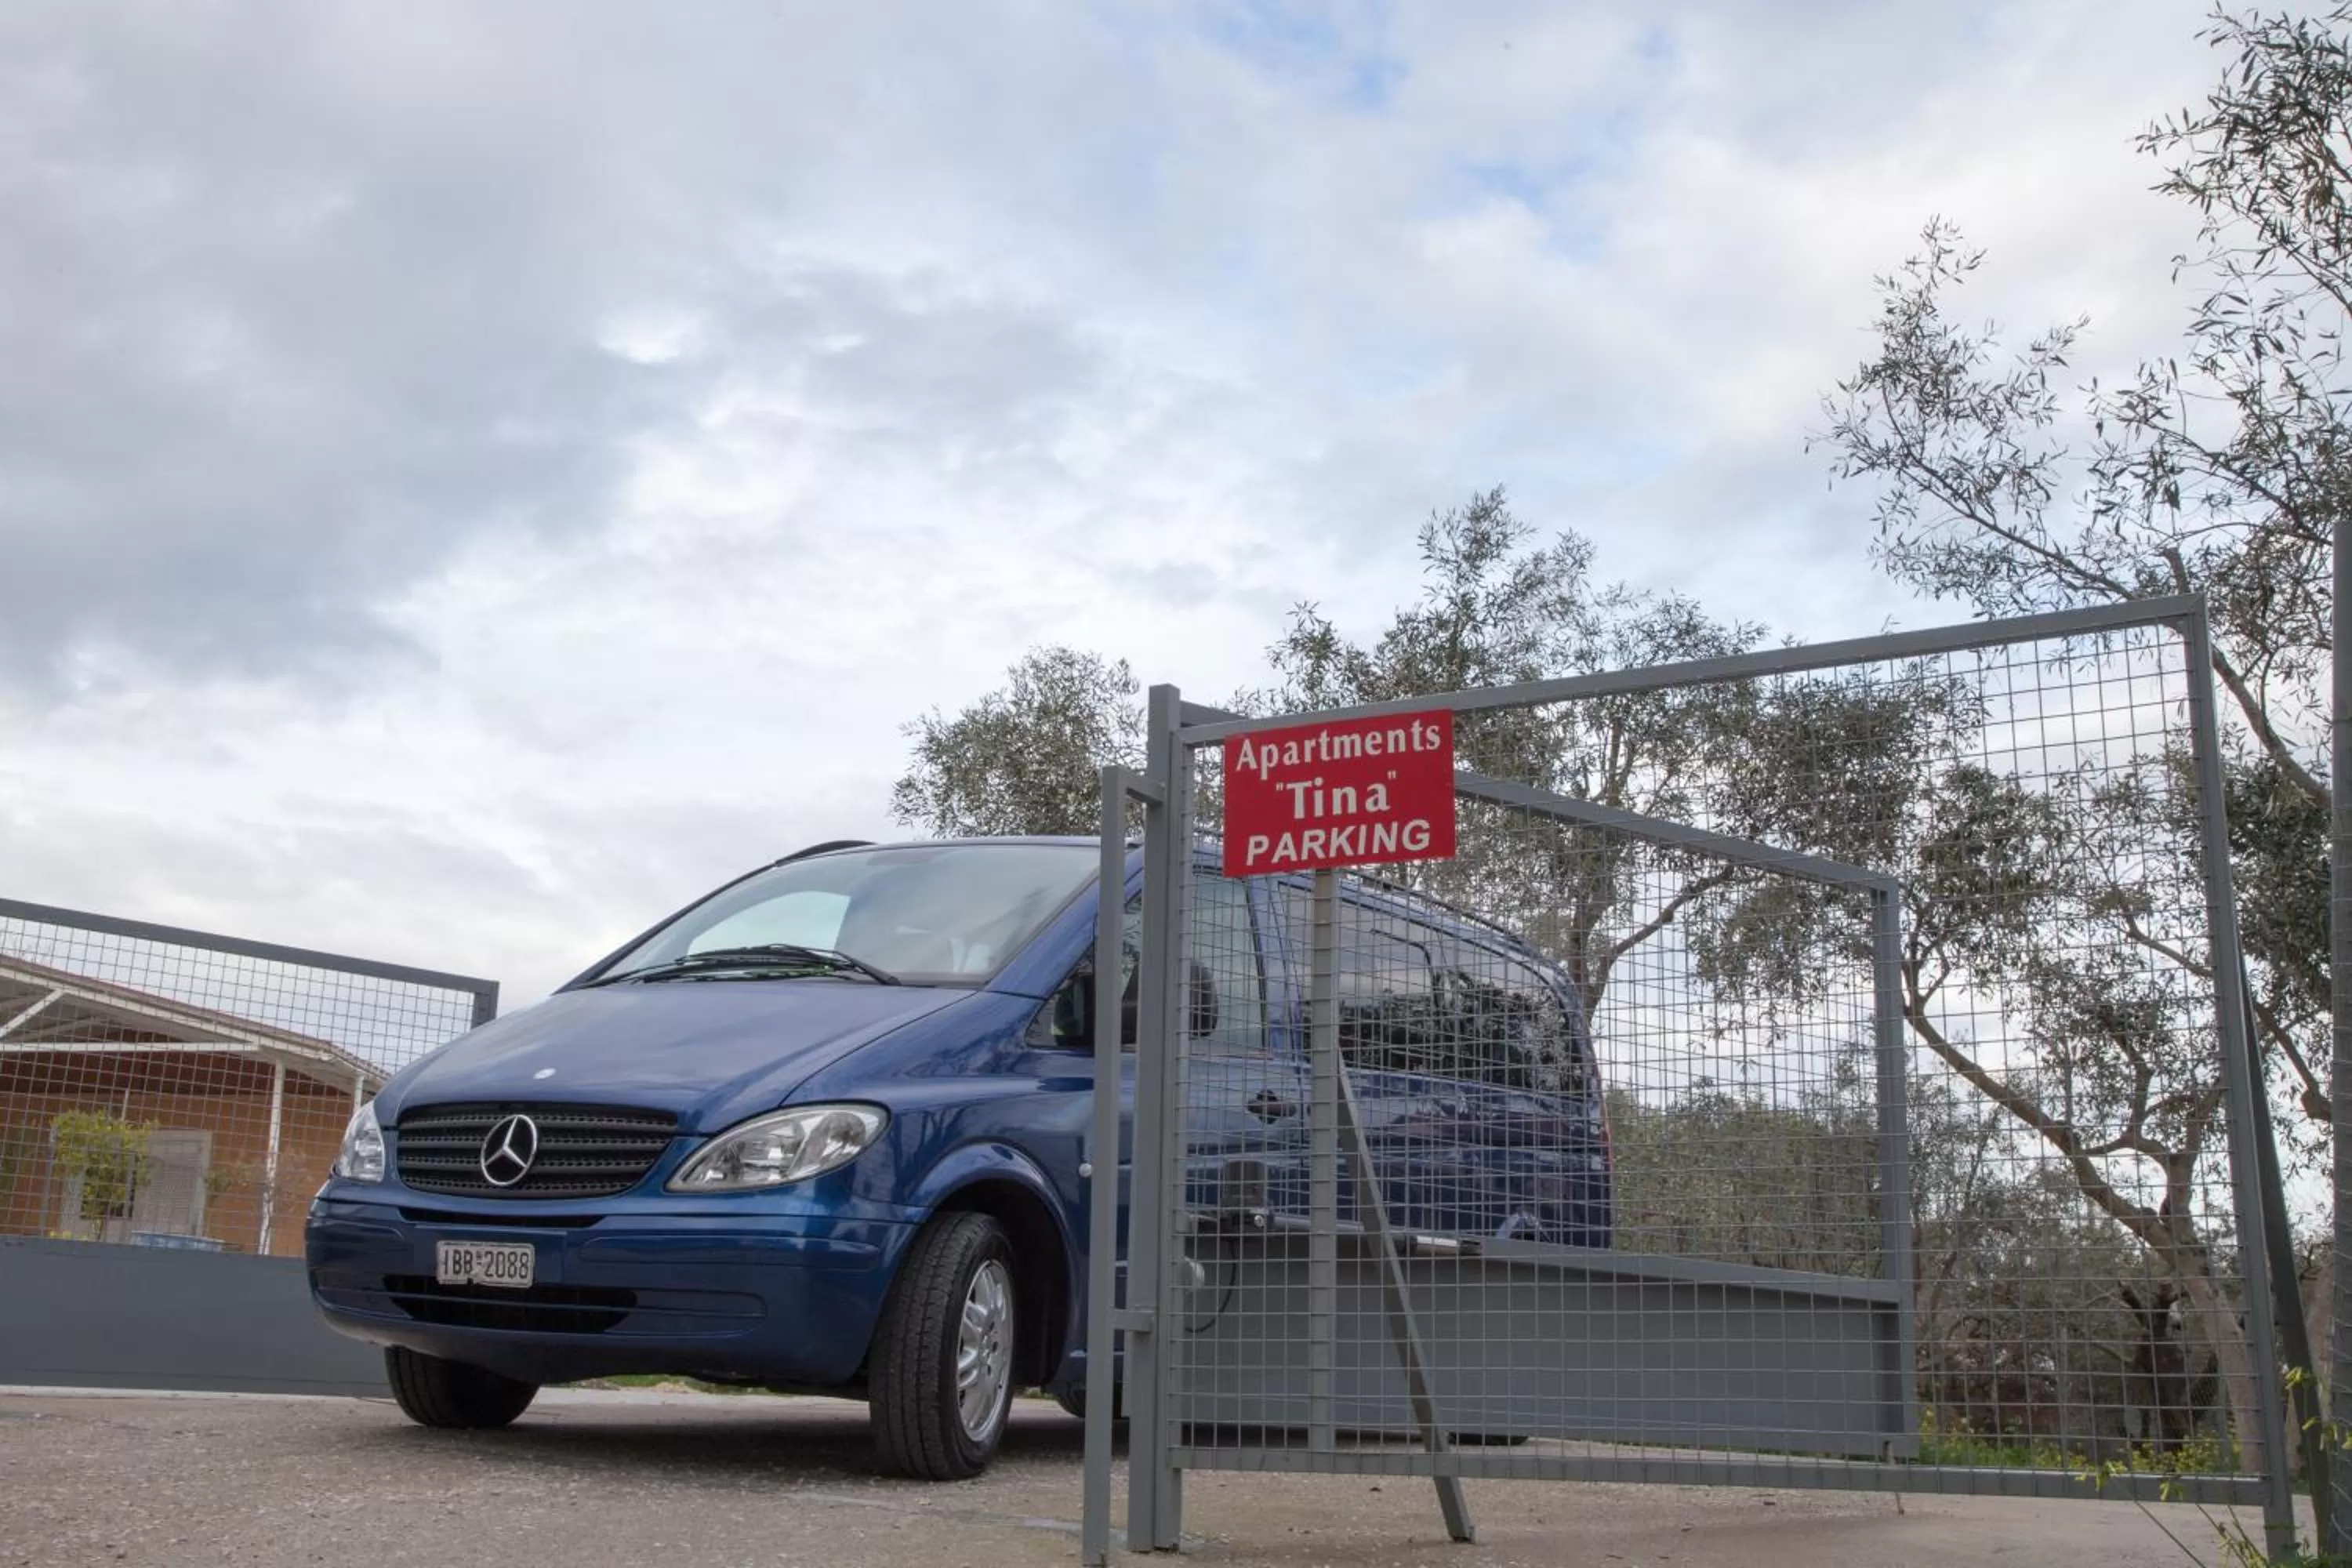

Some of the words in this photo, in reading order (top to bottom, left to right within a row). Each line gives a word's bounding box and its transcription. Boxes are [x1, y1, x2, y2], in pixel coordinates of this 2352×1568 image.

[1236, 718, 1440, 780] Apartments
[1276, 770, 1397, 819] "Tina"
[1246, 819, 1431, 866] PARKING
